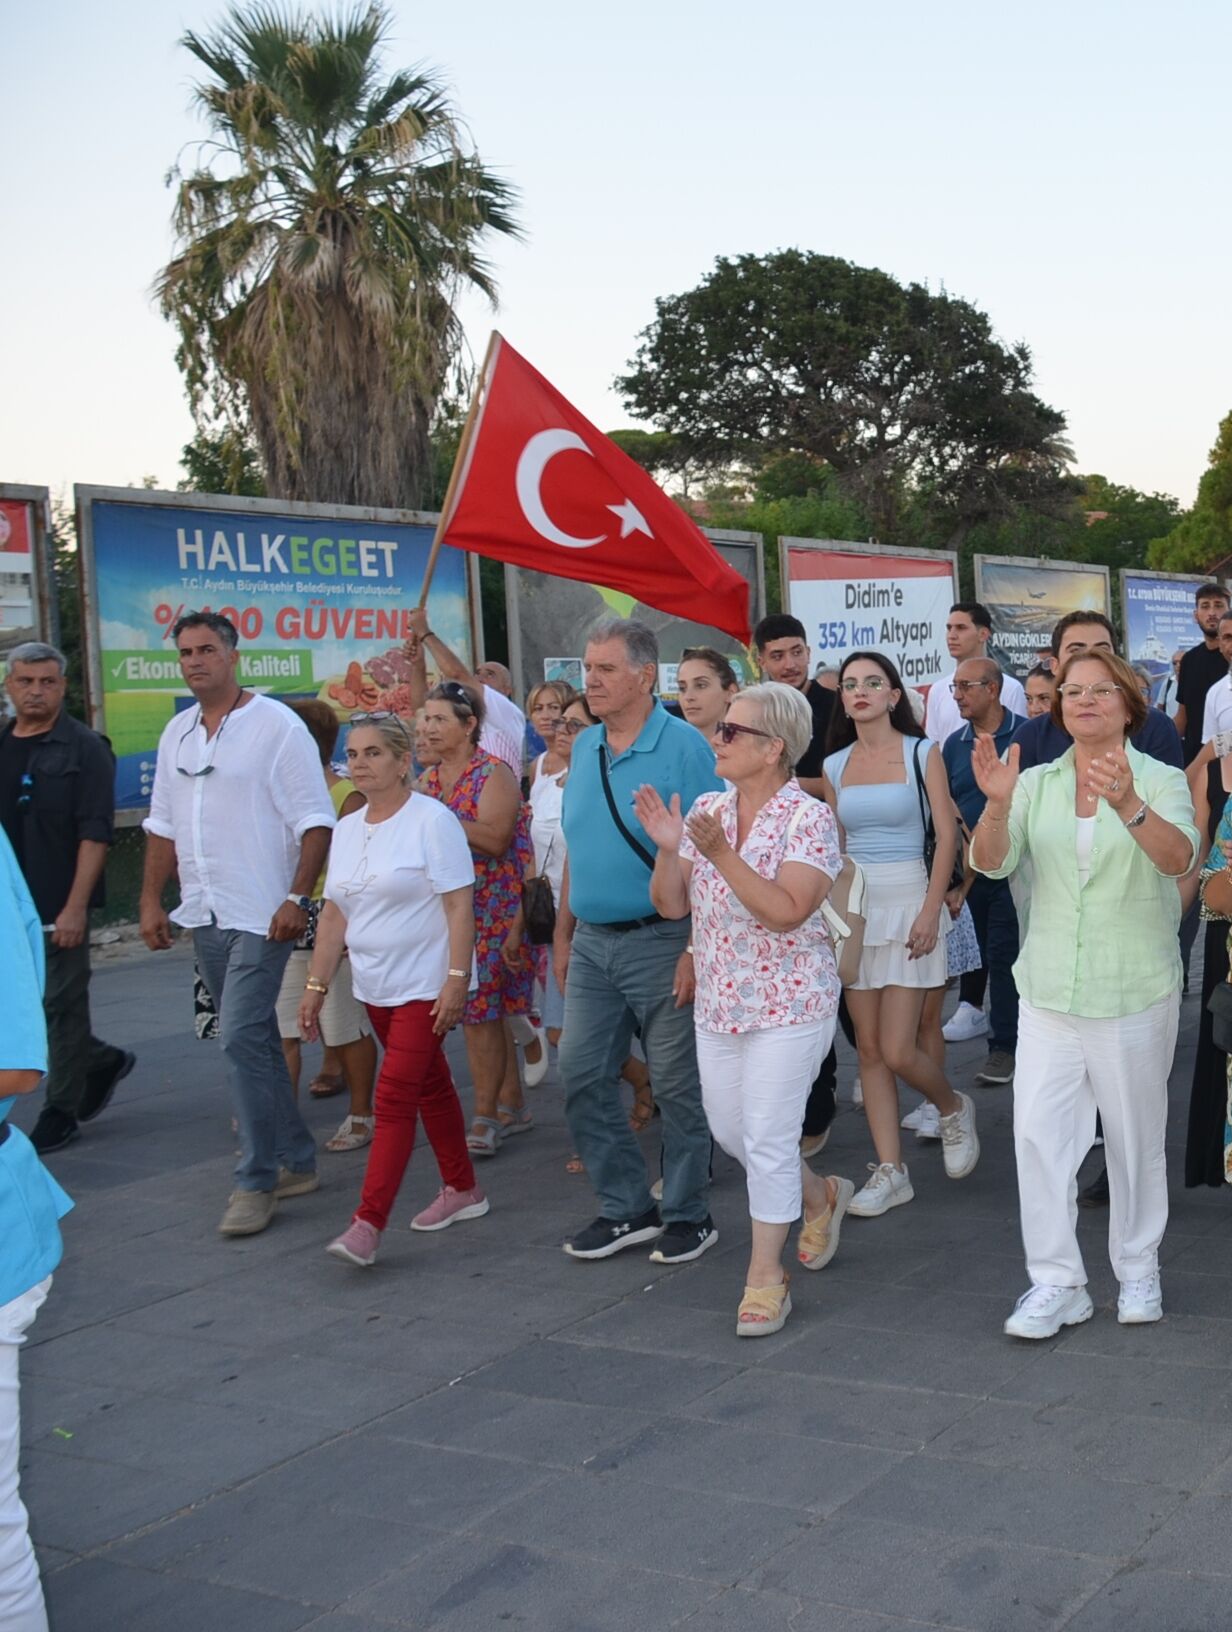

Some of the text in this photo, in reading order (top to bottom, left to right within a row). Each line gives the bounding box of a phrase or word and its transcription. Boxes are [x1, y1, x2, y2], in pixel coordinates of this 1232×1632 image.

[176, 528, 398, 577] HALKEGEET
[845, 582, 903, 609] Didim'e
[818, 617, 932, 649] 352 km Altyapı
[992, 632, 1019, 647] AYDIN
[241, 654, 300, 678] Kaliteli
[897, 649, 941, 682] Yaptık
